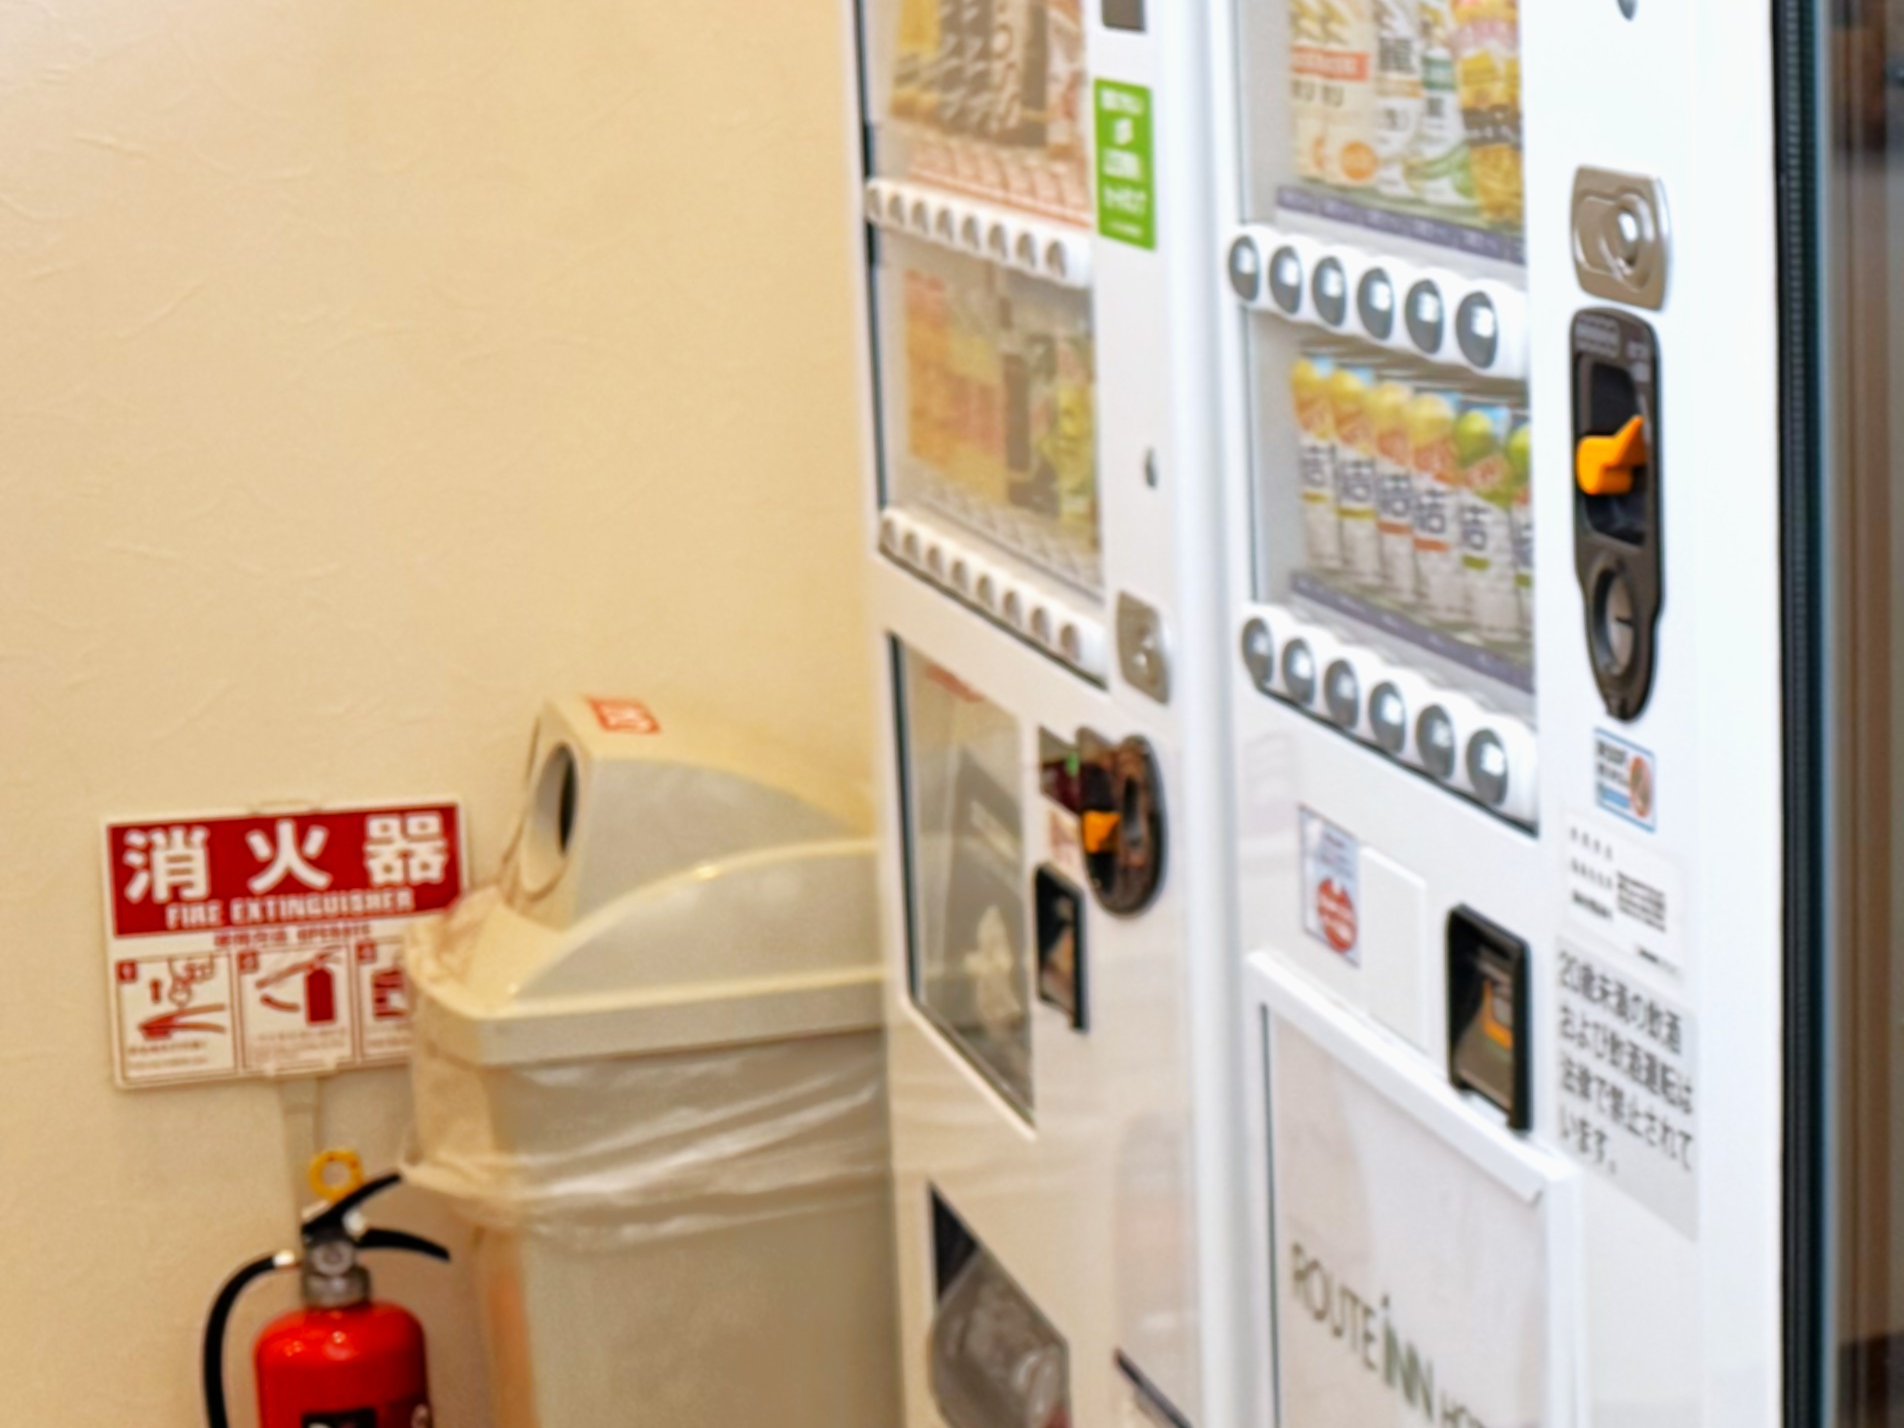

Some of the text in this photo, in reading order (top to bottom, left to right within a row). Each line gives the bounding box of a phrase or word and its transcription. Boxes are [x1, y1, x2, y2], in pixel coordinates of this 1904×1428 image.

[122, 811, 448, 904] 消火器
[166, 886, 416, 929] FIRE EXTINGUISHER
[1289, 1241, 1379, 1373] ROUTE
